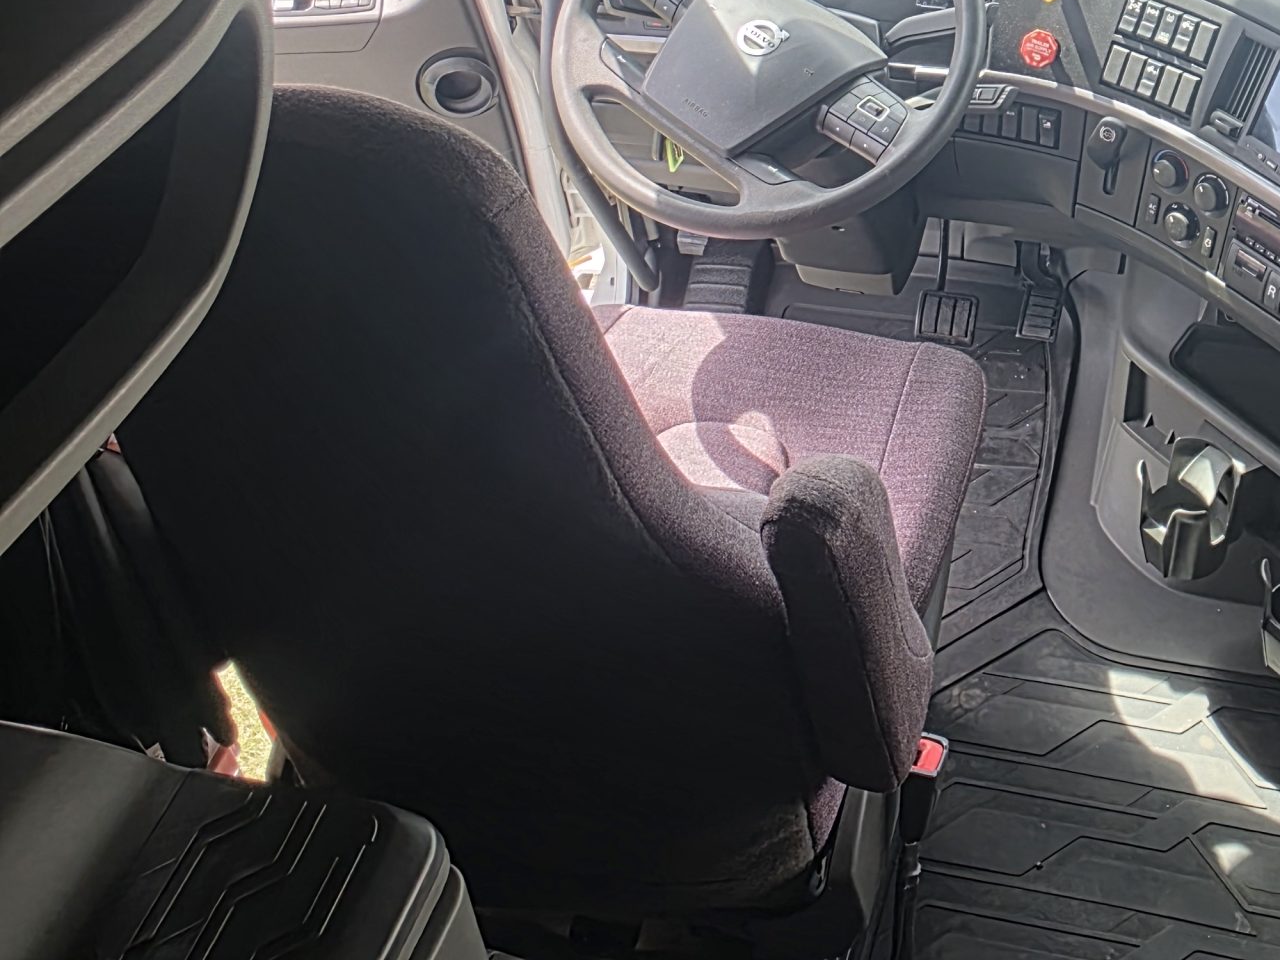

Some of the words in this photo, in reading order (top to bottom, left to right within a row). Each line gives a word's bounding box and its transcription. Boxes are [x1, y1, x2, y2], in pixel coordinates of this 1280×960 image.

[745, 26, 775, 48] OLVO
[682, 98, 708, 118] AIRBAG
[1267, 284, 1277, 299] R
